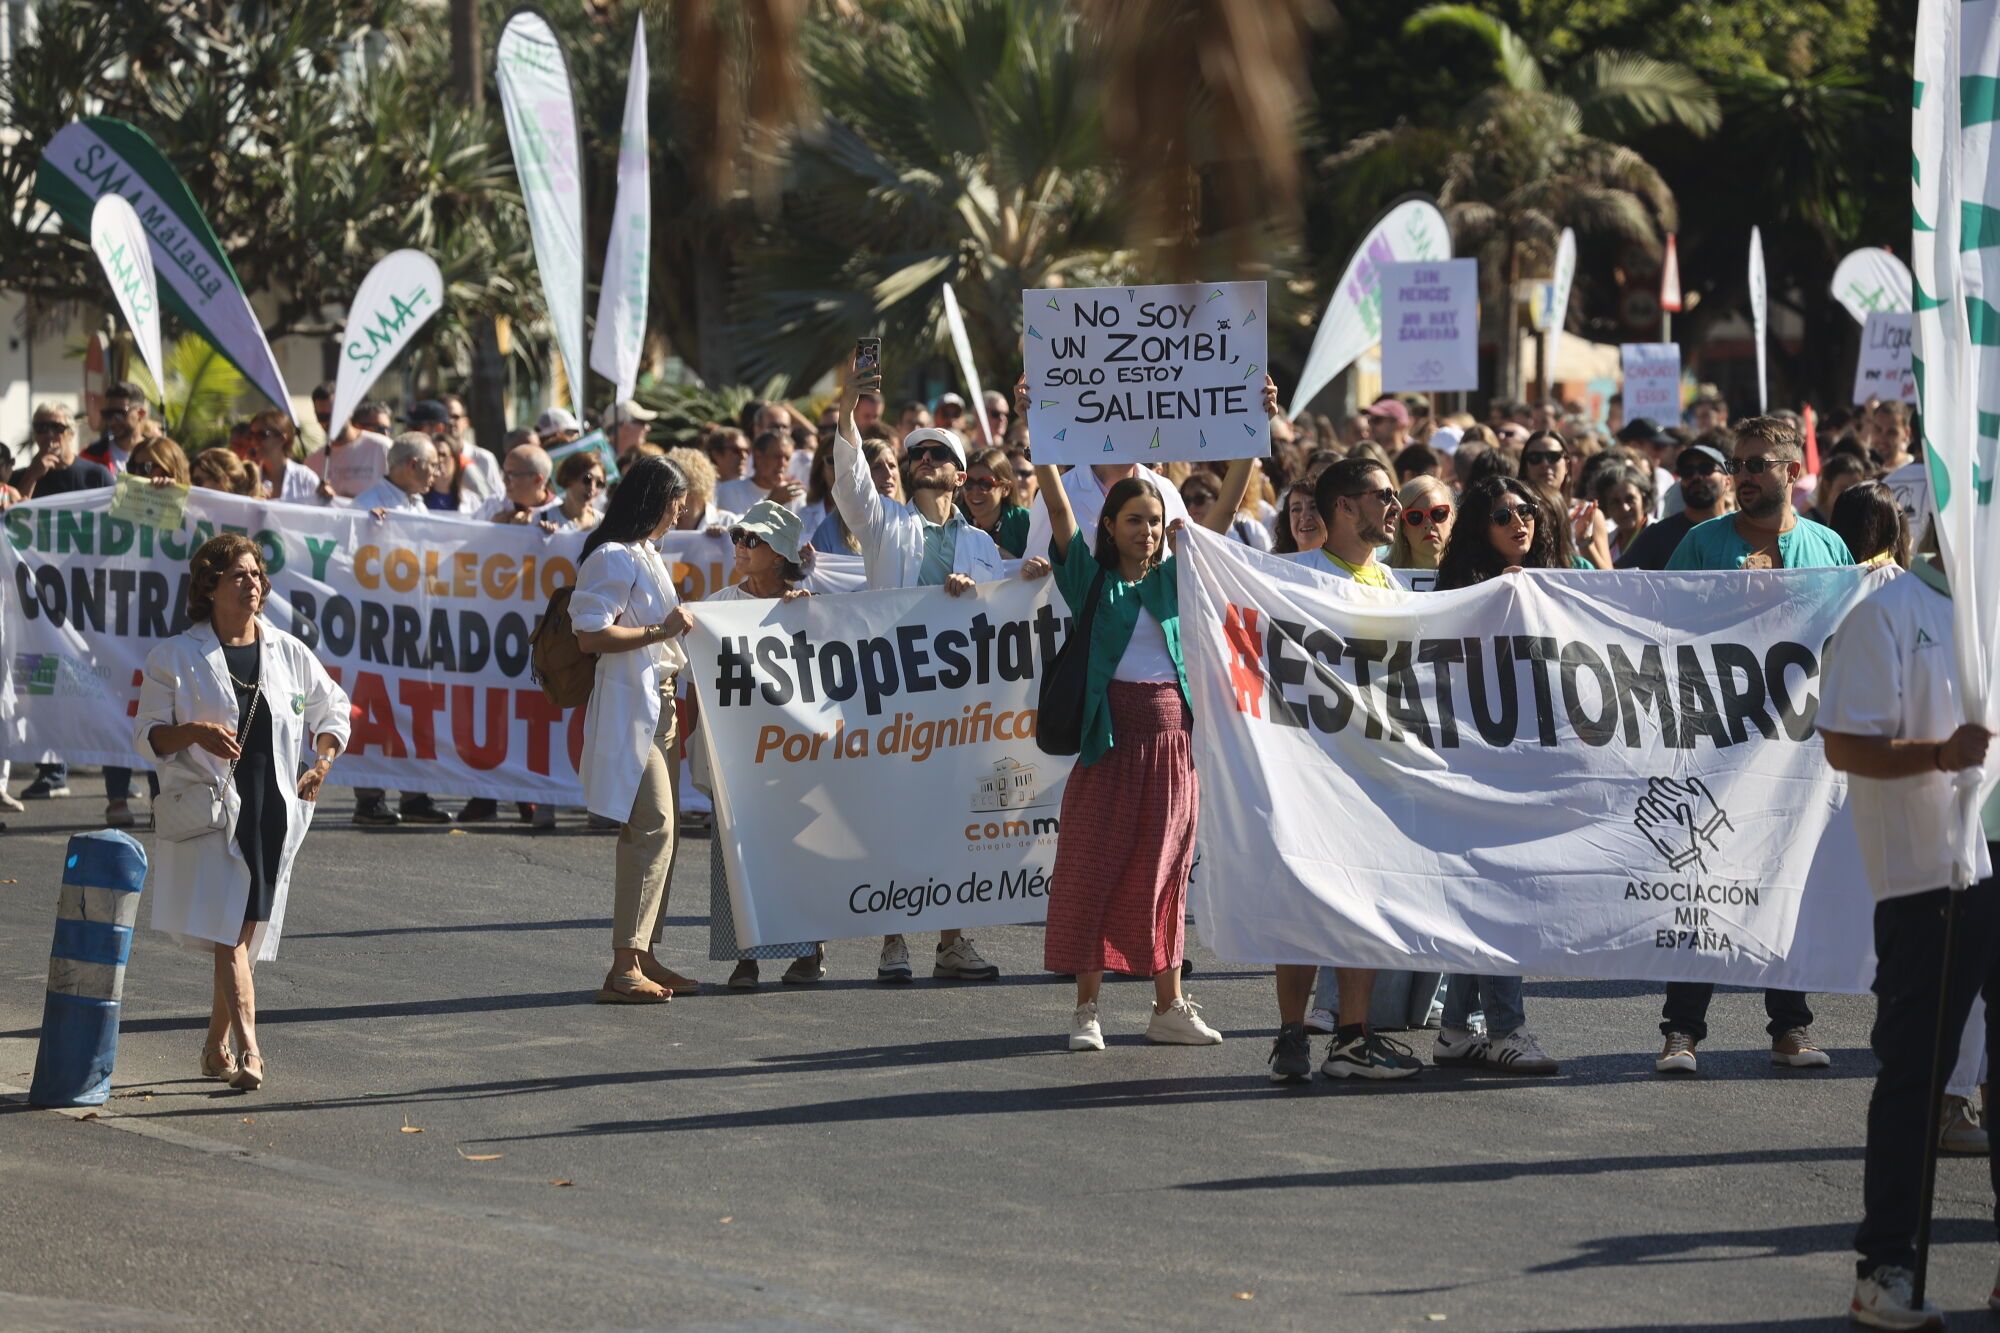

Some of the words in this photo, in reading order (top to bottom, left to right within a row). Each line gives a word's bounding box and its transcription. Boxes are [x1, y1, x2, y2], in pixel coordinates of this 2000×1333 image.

[142, 205, 222, 294] Málaga
[1074, 300, 1120, 328] NO
[1136, 302, 1196, 330] SOY
[1051, 335, 1086, 359] UN
[1044, 367, 1106, 387] SOLO
[1117, 365, 1183, 384] ESTOY
[1074, 384, 1249, 424] SALIENTE
[304, 535, 338, 583] Y
[290, 589, 545, 678] BORRADO
[715, 603, 1072, 716] #StopEstat
[1223, 602, 1835, 750] #ESTATUTOMARC
[755, 724, 829, 764] Por
[833, 719, 870, 760] la
[849, 872, 951, 917] Colegio
[956, 871, 993, 904] de
[1624, 880, 1760, 906] ASOCIACIÓN
[1674, 906, 1709, 927] MIR
[1655, 928, 1733, 952] ESPAÑA
